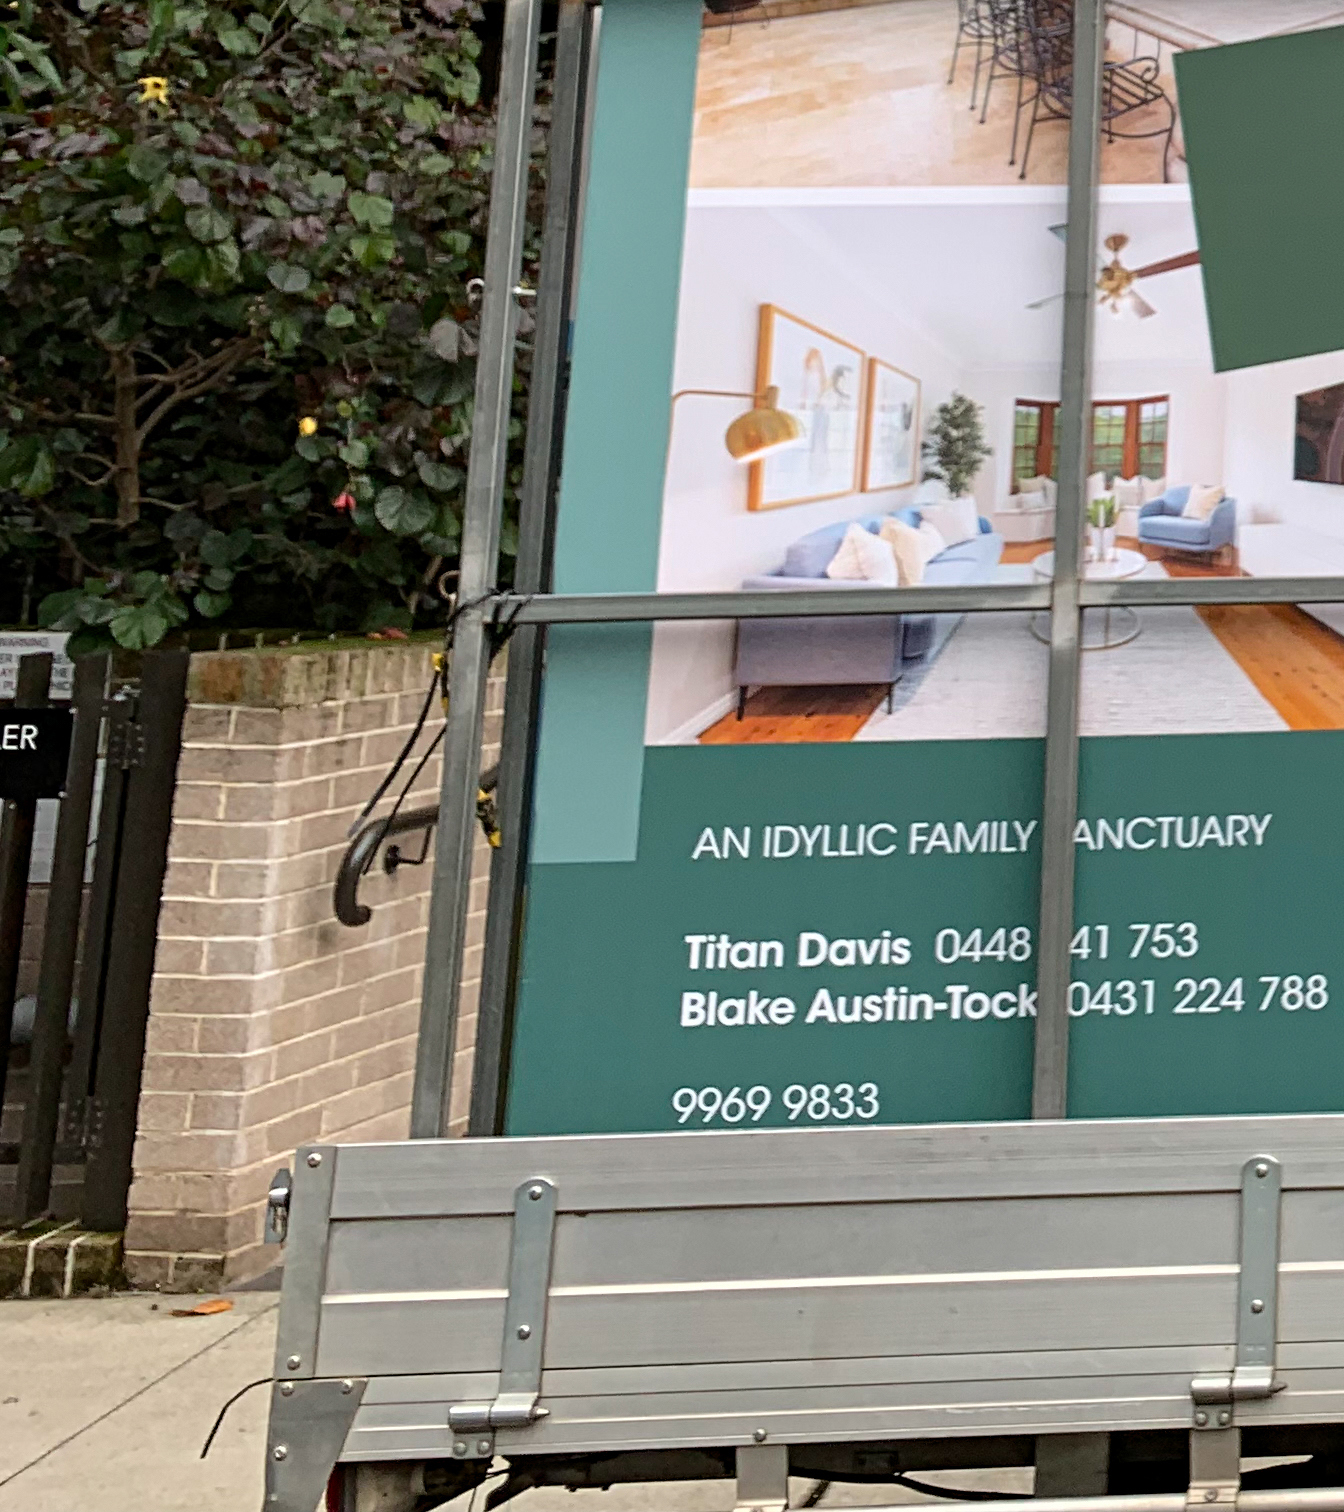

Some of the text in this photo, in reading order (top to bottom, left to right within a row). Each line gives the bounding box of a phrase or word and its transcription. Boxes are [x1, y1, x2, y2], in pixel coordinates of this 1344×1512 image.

[0, 723, 39, 751] ER
[690, 813, 1274, 860] AN IDYLLIC FAMILY ANCTUARY
[684, 921, 1200, 970] Titan Davis 0448 41 753
[679, 974, 1330, 1028] Blake Austin-Tock 0431 224 788
[672, 1082, 880, 1124] 9969 9833
